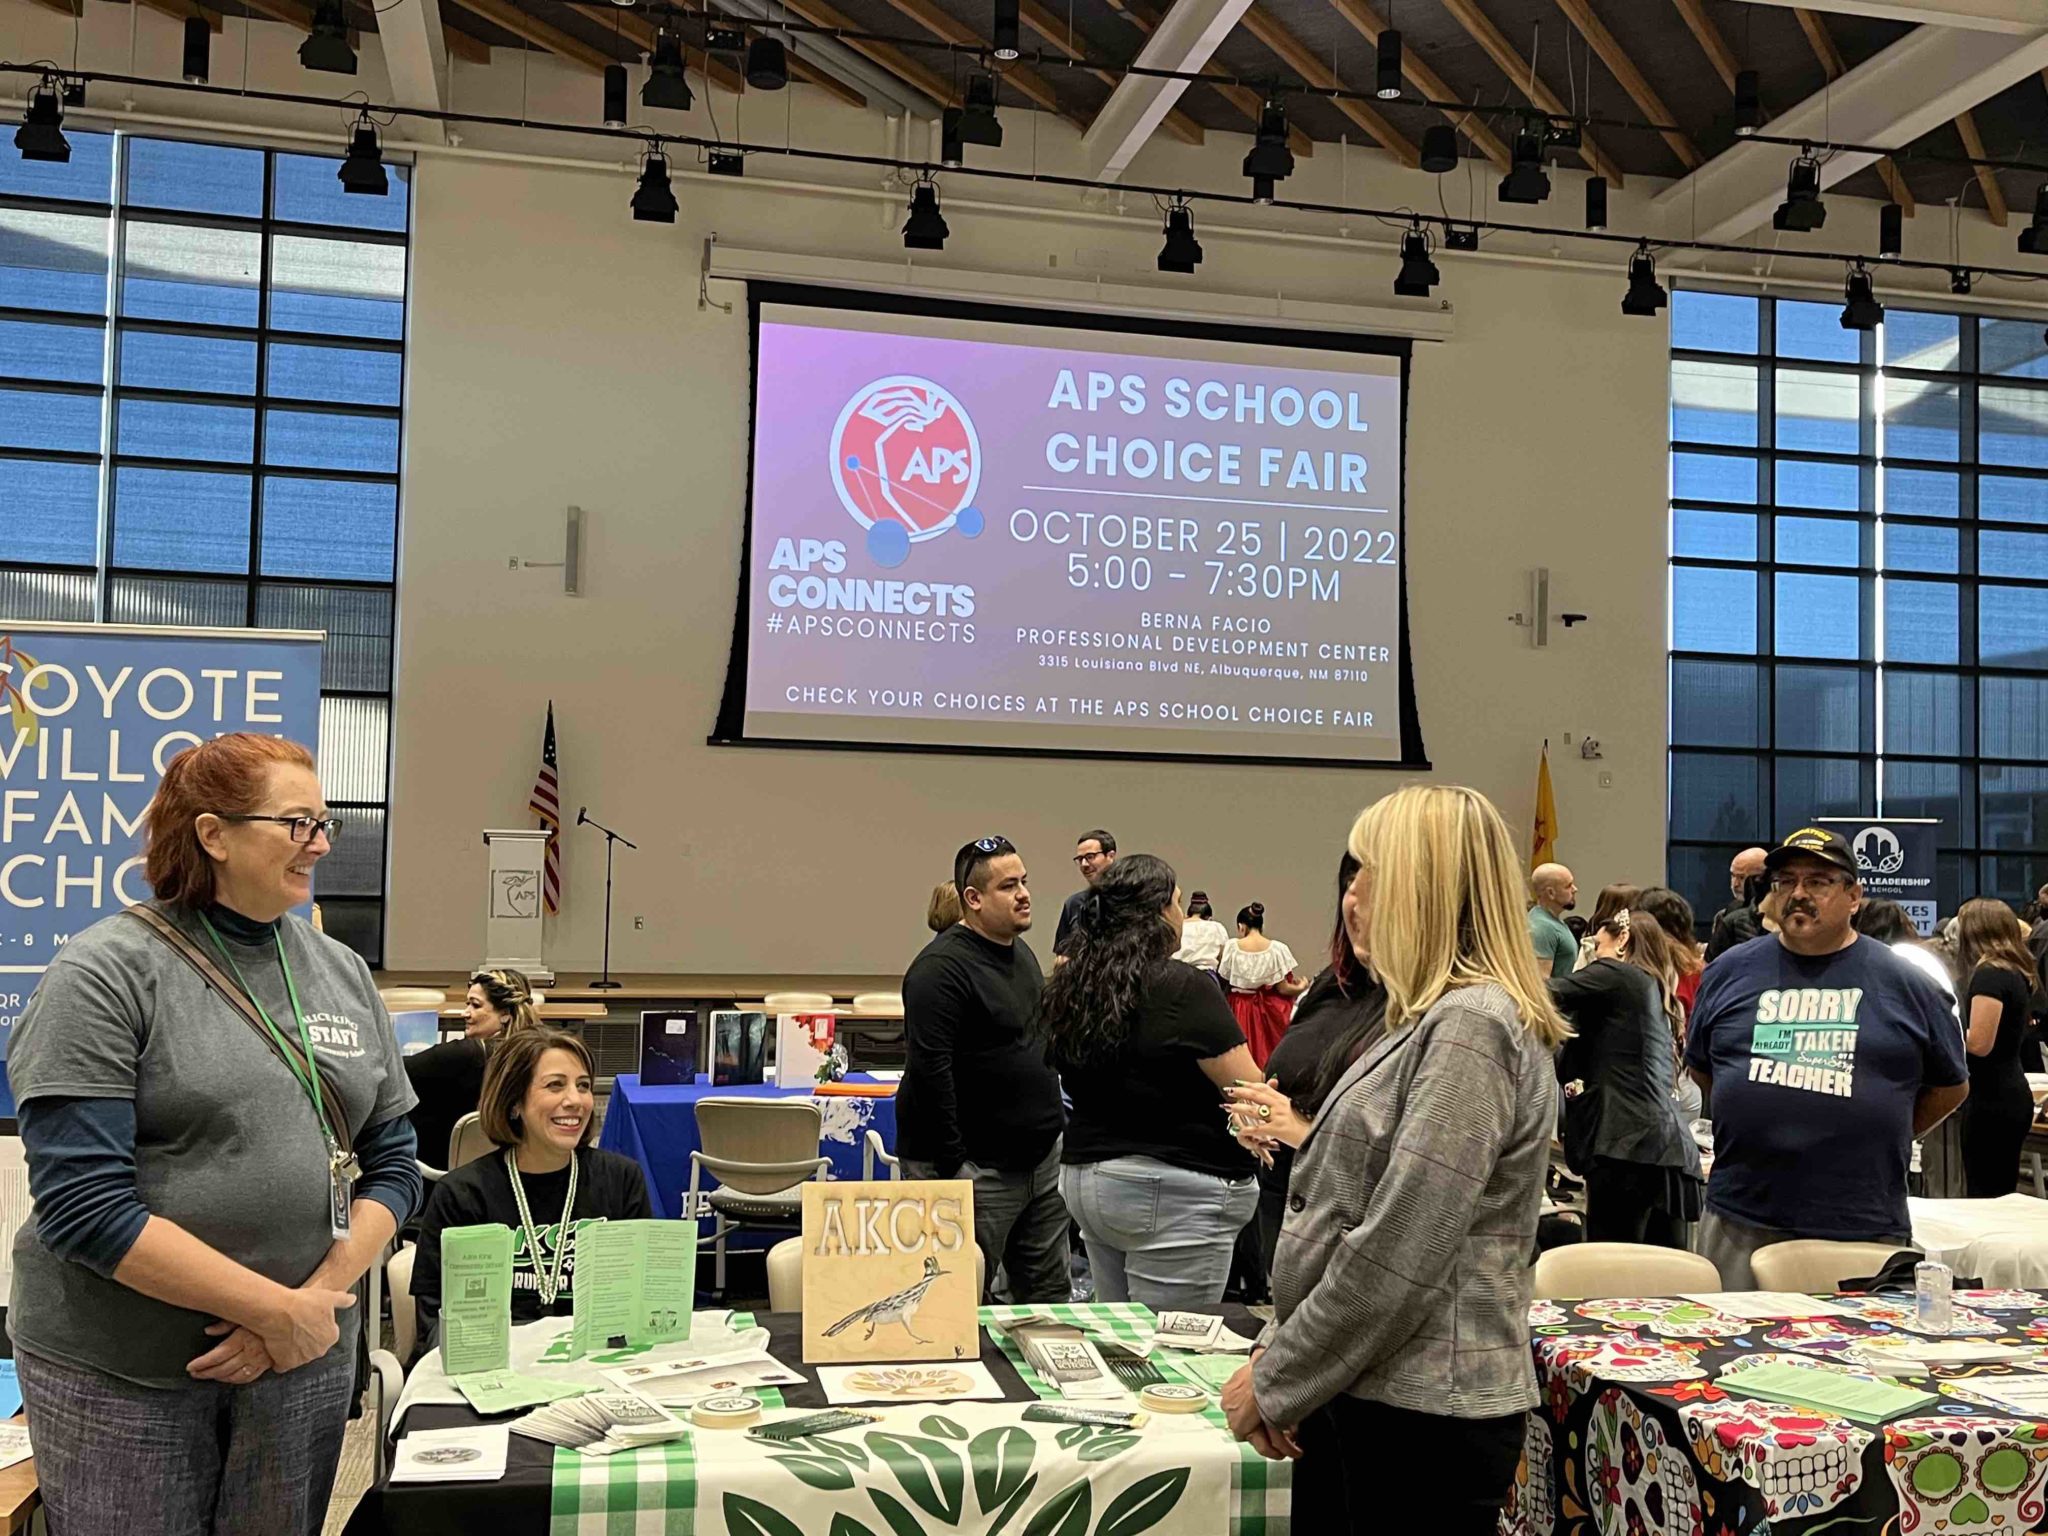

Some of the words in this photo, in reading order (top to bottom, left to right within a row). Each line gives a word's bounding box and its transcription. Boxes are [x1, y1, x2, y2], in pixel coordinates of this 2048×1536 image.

[1048, 369, 1146, 415] APS
[1164, 377, 1369, 432] SCHOOL
[901, 446, 970, 485] APS
[1046, 432, 1241, 485] CHOICE
[1259, 447, 1368, 494] FAIR
[1009, 508, 1199, 553] OCTOBER
[1215, 520, 1262, 556] 25
[1303, 525, 1397, 565] 2022
[768, 537, 847, 573] APS
[1067, 552, 1152, 591] 5:00
[1204, 560, 1340, 603] 7:30PM
[768, 574, 976, 618] CONNECTS
[766, 612, 976, 643] #APSCONNECTS
[1141, 611, 1202, 630] BERNA
[1212, 615, 1271, 634] FACIO
[1016, 627, 1163, 651] PROFESSIONAL
[1172, 636, 1309, 659] DEVELOPMENT
[1318, 643, 1390, 663] CENTER
[1038, 654, 1069, 668] 3315
[1074, 656, 1143, 672] Louisiana
[1149, 660, 1179, 673] Blvd
[1184, 662, 1205, 676] NE,
[1210, 663, 1304, 681] Albuquerque,
[1309, 668, 1328, 680] NM
[1334, 669, 1368, 682] 87110
[786, 685, 858, 705] CHECK
[868, 689, 922, 708] YOUR
[933, 692, 1026, 712] CHOICES
[1035, 696, 1059, 713] AT
[1069, 698, 1104, 715] THE
[1113, 700, 1149, 718] APS
[1159, 702, 1239, 722] SCHOOL
[1248, 706, 1323, 725] CHOICE
[1333, 710, 1373, 727] FAIR
[514, 891, 536, 901] APS
[1869, 878, 1931, 887] LEADERSHIP
[1757, 988, 1863, 1023] SORRY
[309, 1025, 358, 1047] STAFF
[1754, 1041, 1790, 1050] ALREADY
[1779, 1029, 1792, 1038] I'M
[1794, 1031, 1857, 1051] TAKEN
[1748, 1058, 1853, 1098] TEACHER
[814, 1198, 965, 1256] AKCS
